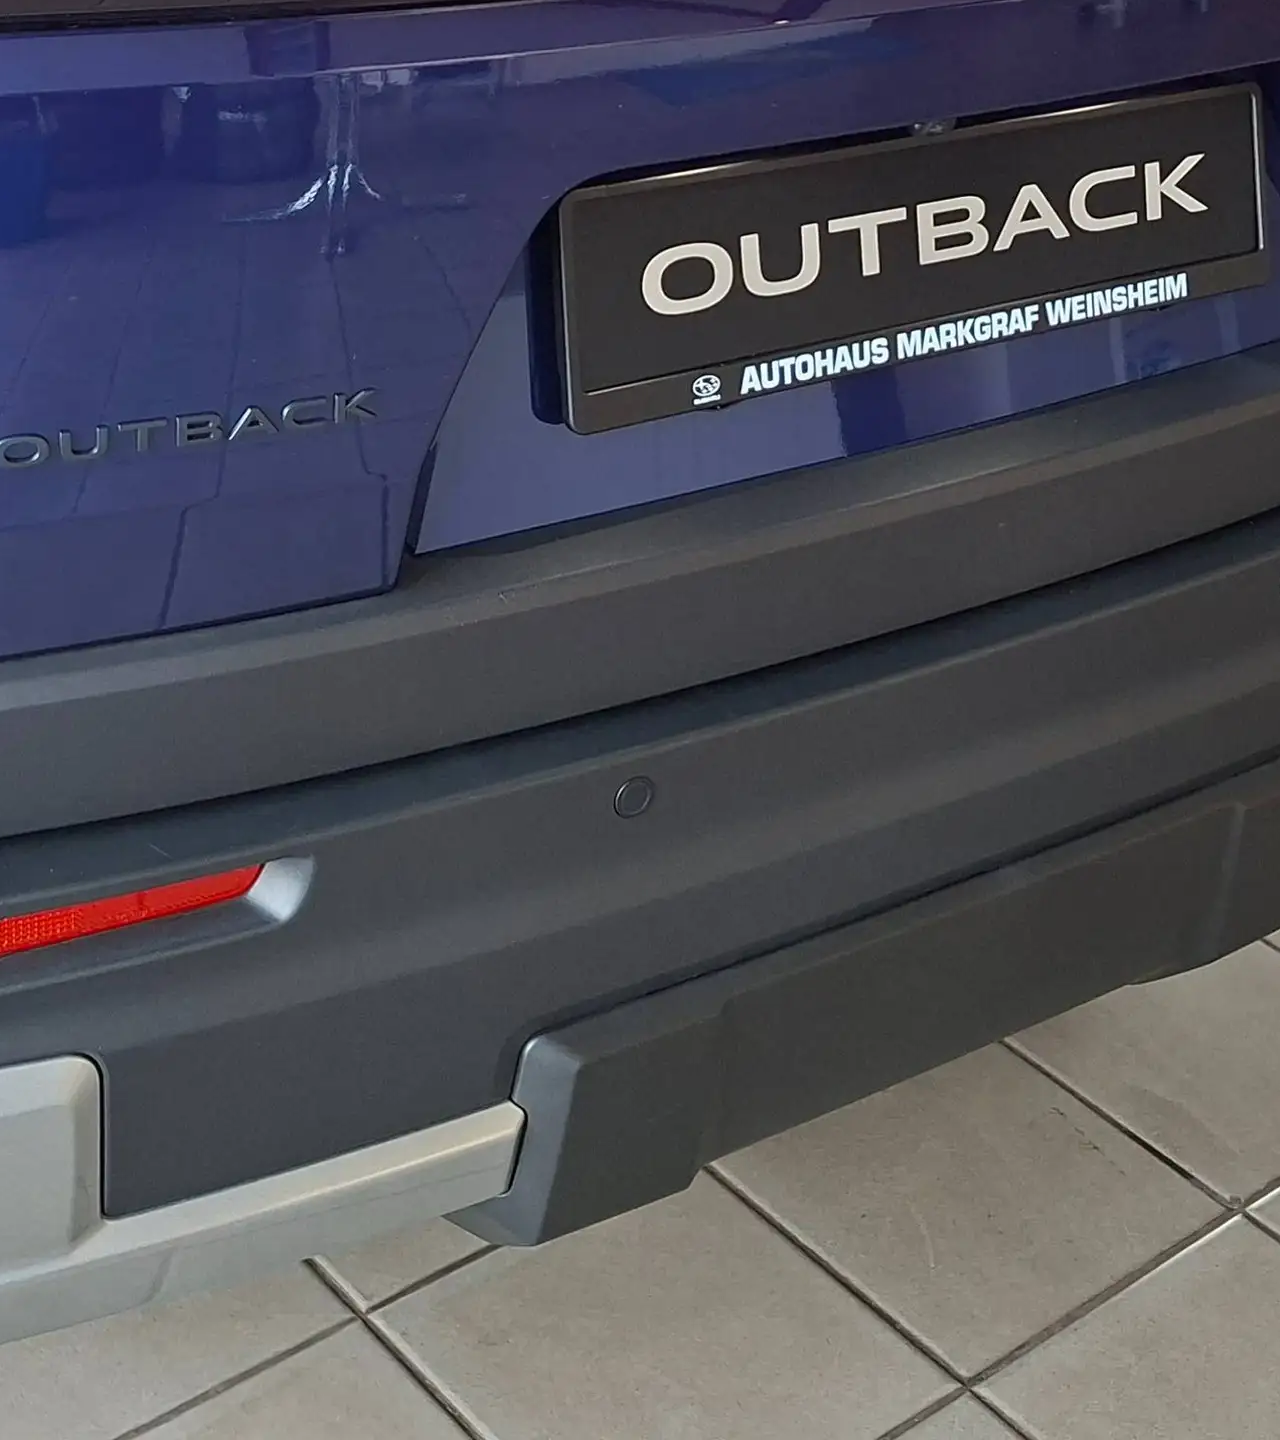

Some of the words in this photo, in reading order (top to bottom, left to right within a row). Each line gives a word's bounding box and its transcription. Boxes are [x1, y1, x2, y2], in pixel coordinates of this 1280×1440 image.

[641, 152, 1209, 317] OUTBACK
[740, 336, 890, 395] AUTOHAUS
[896, 302, 1039, 359] MARKGRAF
[1045, 272, 1188, 327] WEINSHEIM
